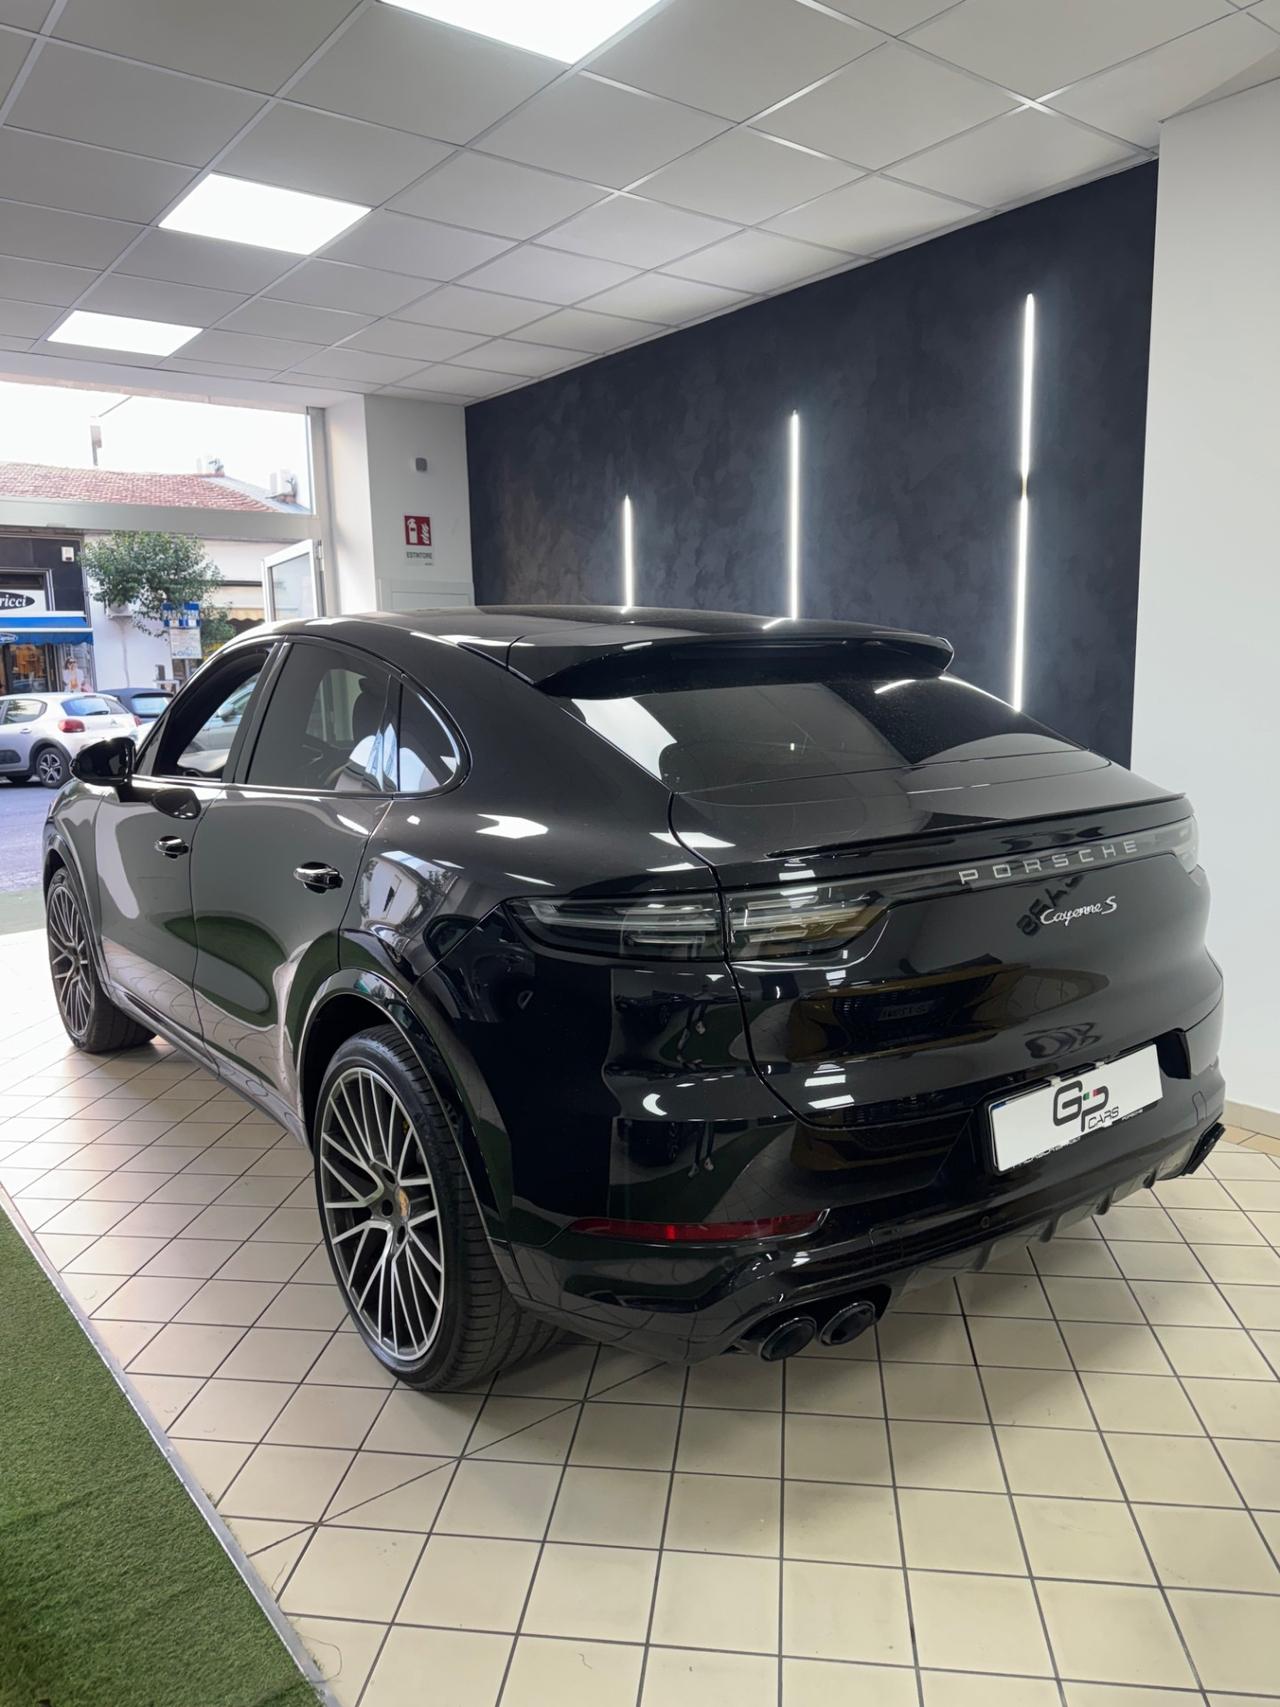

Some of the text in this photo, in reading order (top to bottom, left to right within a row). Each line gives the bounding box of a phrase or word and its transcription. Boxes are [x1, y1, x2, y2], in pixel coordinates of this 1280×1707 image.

[958, 839, 1138, 885] PORSCHE
[1040, 895, 1118, 926] Cayenne S
[1088, 1106, 1119, 1129] CARS
